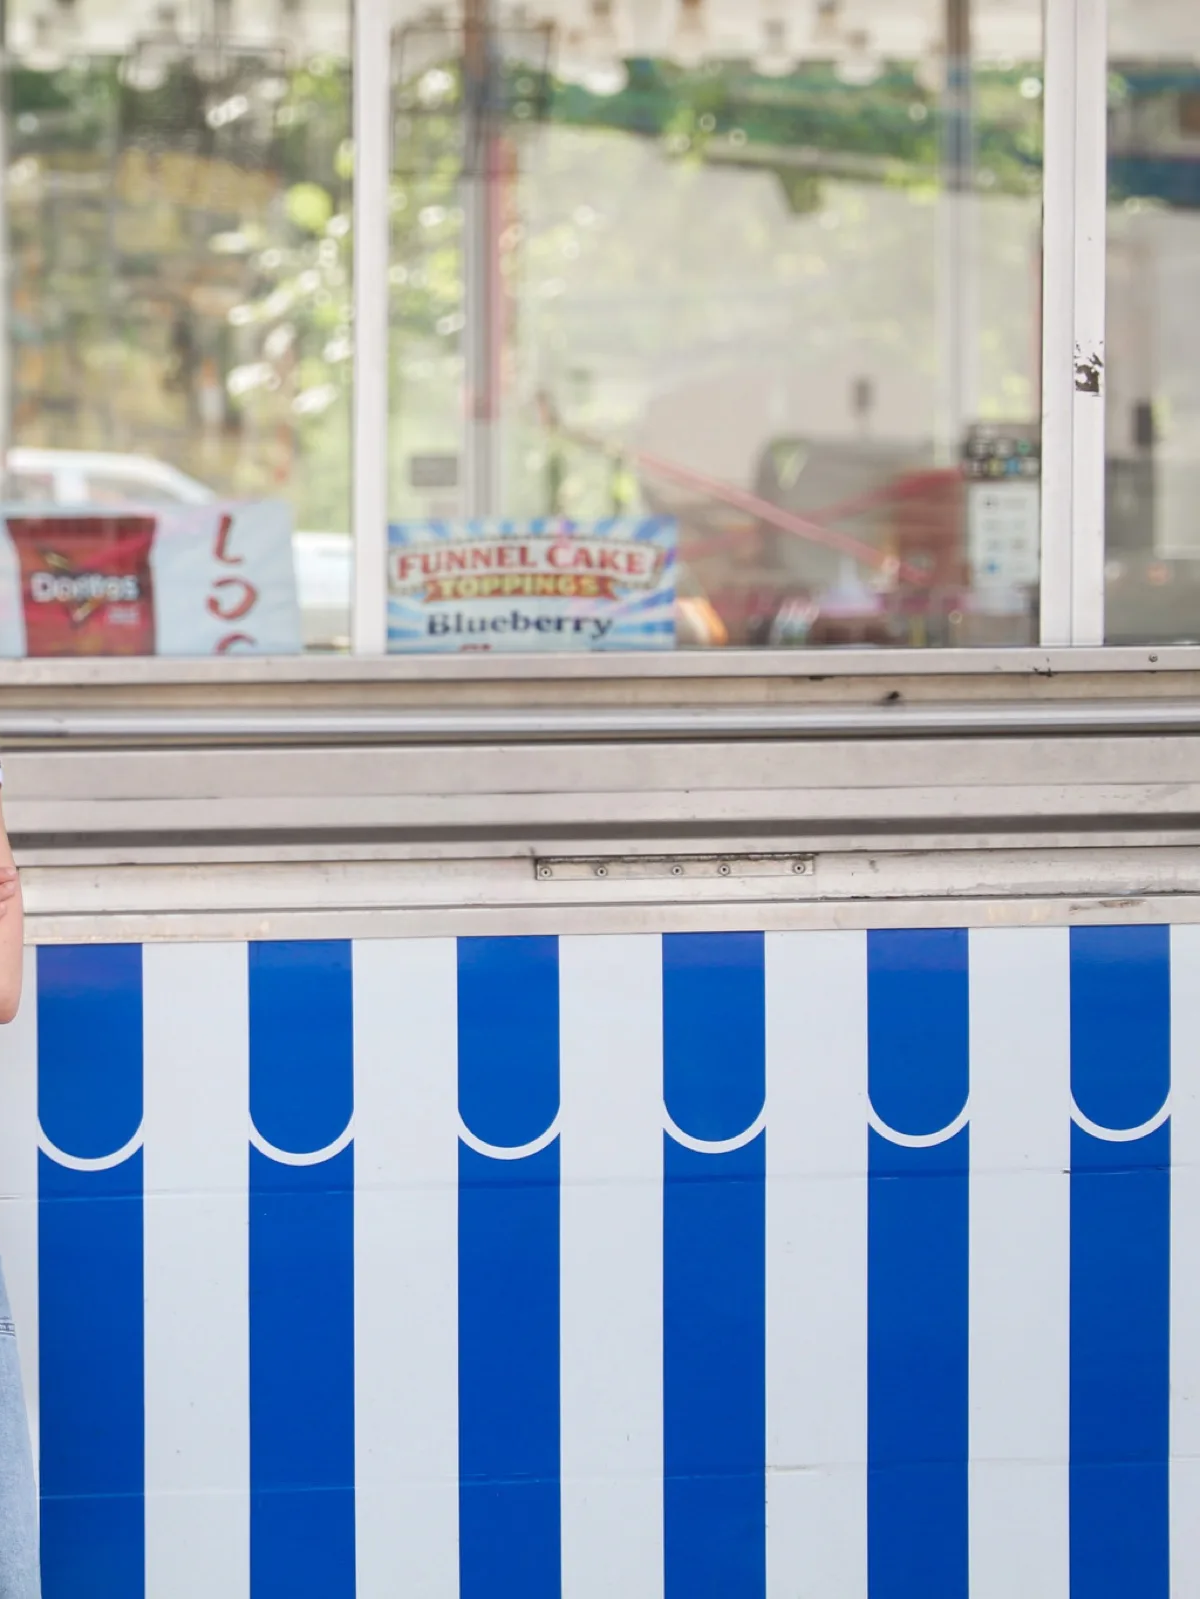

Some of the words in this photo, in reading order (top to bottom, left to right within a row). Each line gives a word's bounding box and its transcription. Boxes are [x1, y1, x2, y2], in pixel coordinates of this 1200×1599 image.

[397, 545, 538, 580] FUNNEL
[545, 544, 646, 576] CAKE
[437, 574, 602, 597] TOPPINGS
[426, 609, 614, 639] Blueberry
